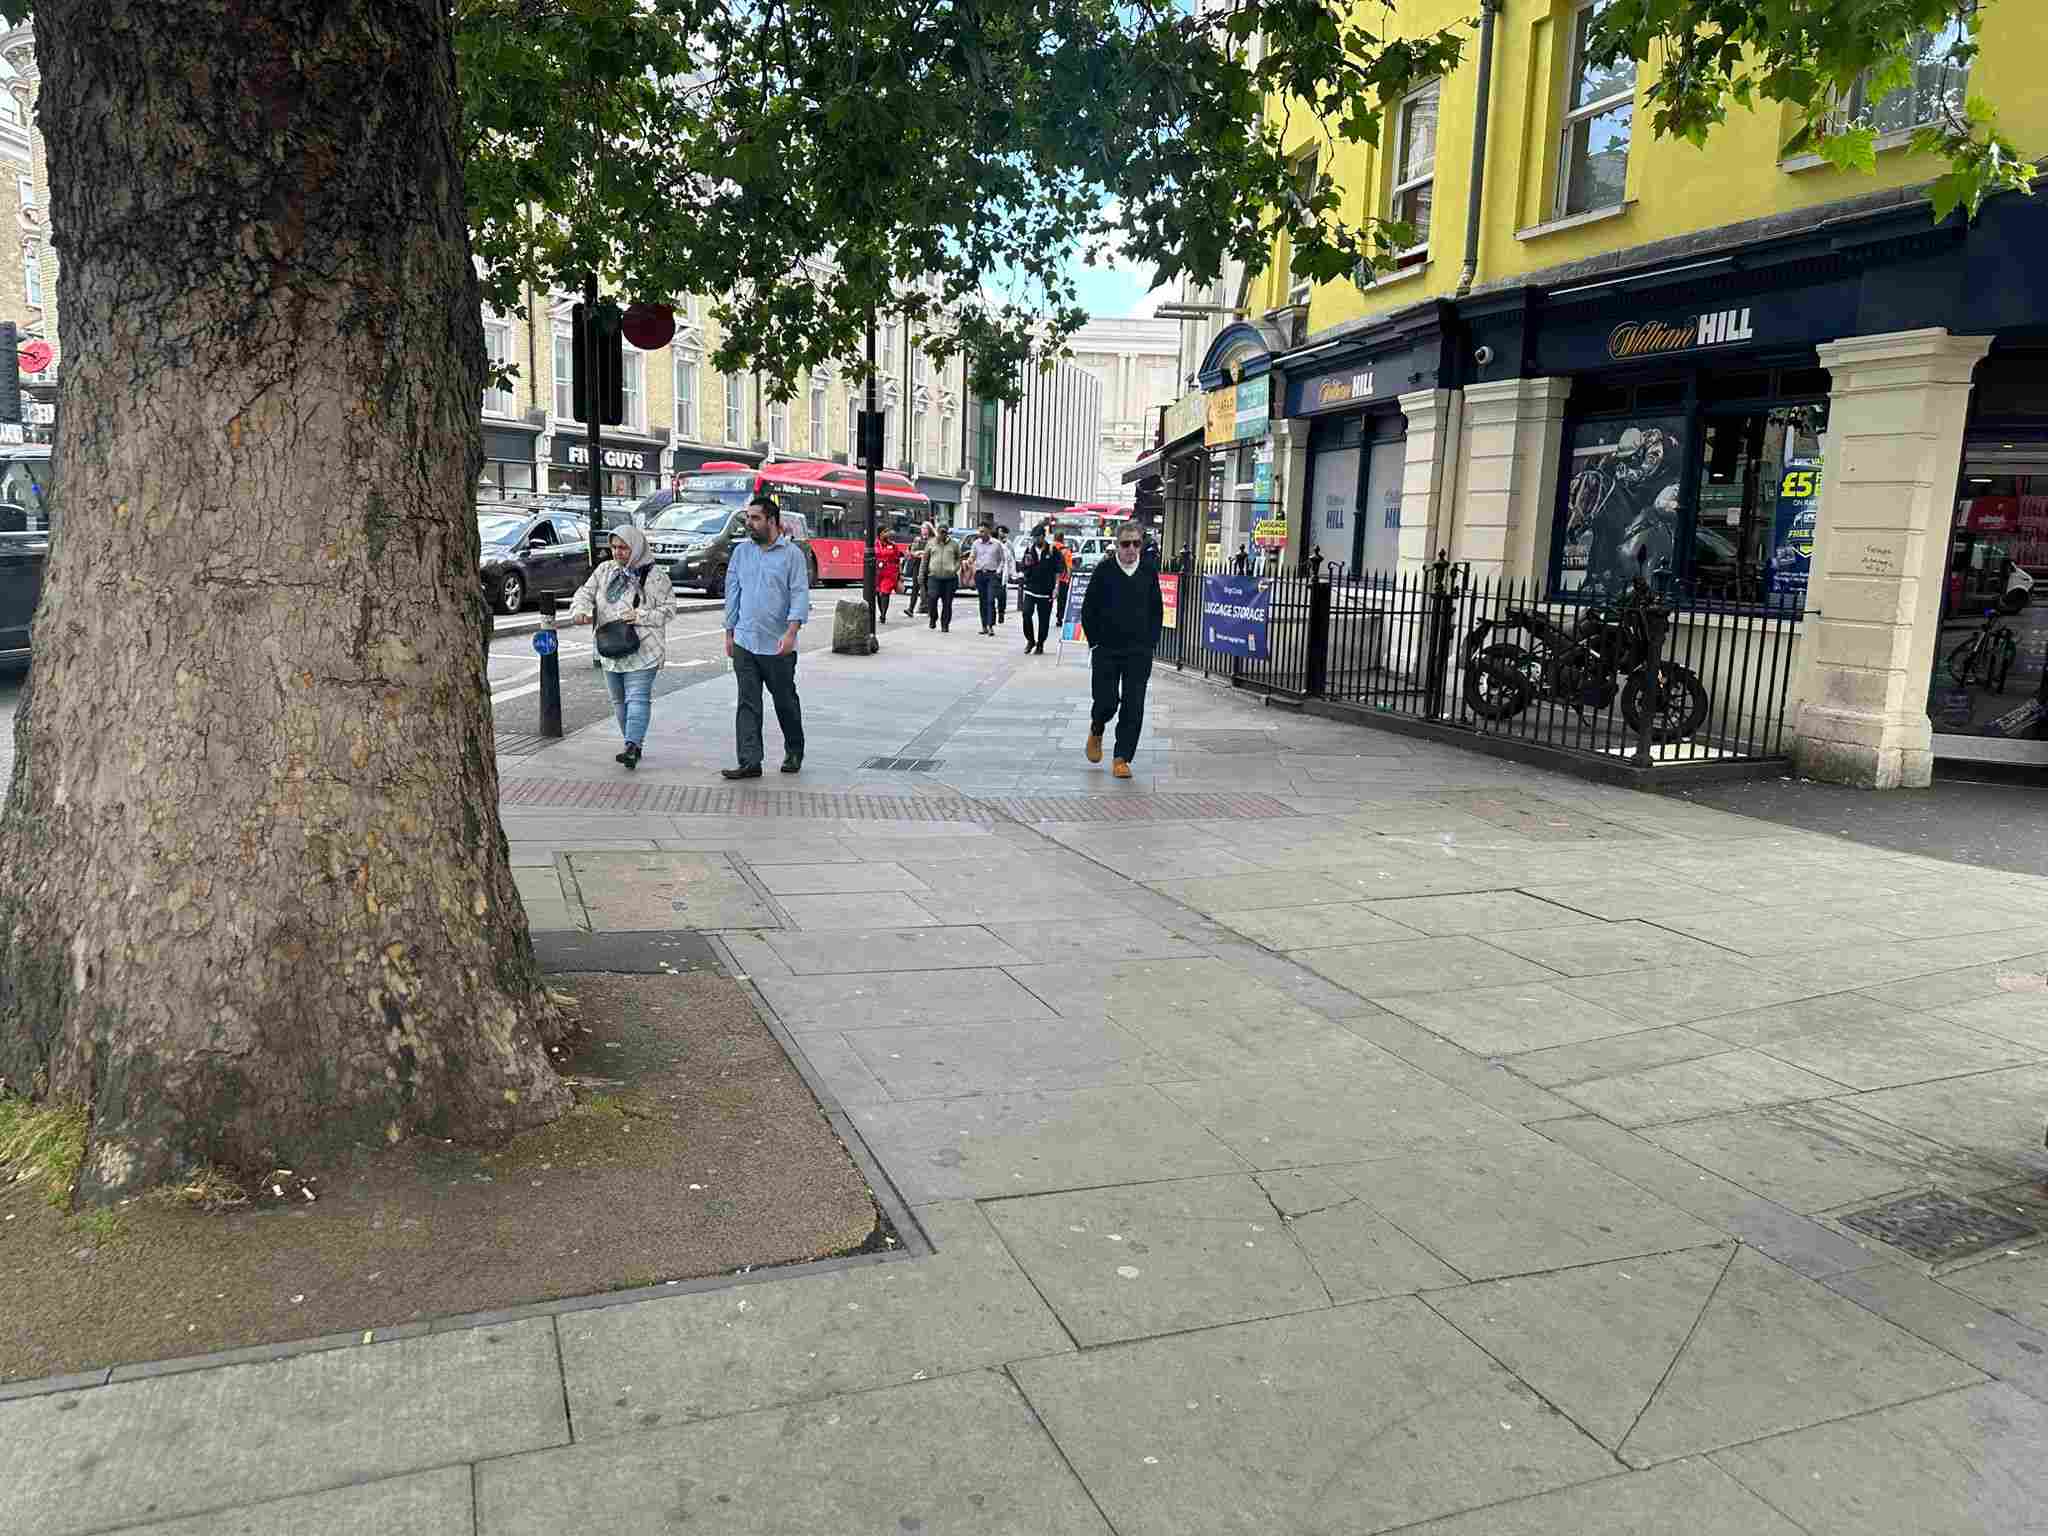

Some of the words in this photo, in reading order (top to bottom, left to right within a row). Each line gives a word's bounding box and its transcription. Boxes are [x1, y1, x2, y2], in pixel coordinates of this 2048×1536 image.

[1608, 316, 1698, 360] William
[1697, 308, 1753, 345] HILL
[1351, 372, 1374, 398] HILL
[604, 450, 643, 470] GUYS
[1780, 471, 1813, 497] £5
[1326, 509, 1345, 529] HILL
[1384, 507, 1401, 529] HIL
[1204, 601, 1233, 617] LUGGAGE
[1233, 605, 1265, 622] STORAGE
